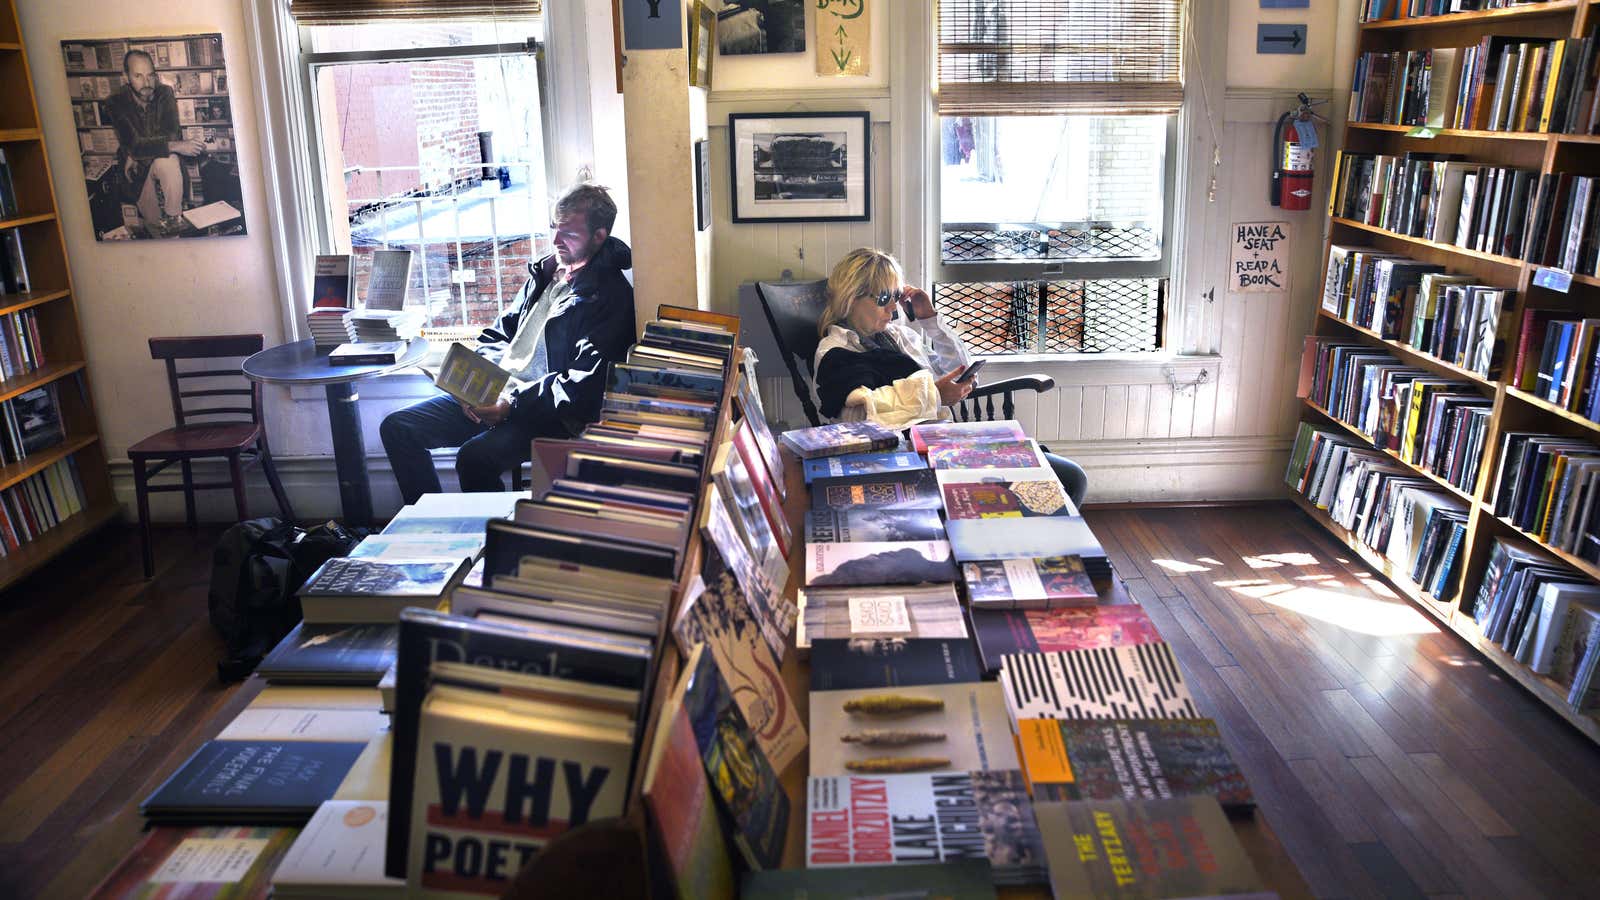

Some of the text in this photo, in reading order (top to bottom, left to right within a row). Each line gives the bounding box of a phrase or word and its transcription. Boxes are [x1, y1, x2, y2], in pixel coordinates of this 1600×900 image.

[645, 0, 661, 19] Y
[1237, 225, 1286, 243] HAVE A
[1243, 238, 1279, 250] SEAT
[1236, 258, 1282, 274] READ A
[1239, 274, 1280, 287] BOOK
[257, 745, 283, 765] THE
[1102, 727, 1118, 749] HAS
[1116, 723, 1151, 787] APPOINTMENT
[1136, 731, 1155, 759] DAWN
[202, 746, 258, 795] VOICEMAILS
[224, 765, 265, 796] FINAL
[1108, 747, 1130, 784] FUTURE
[434, 742, 610, 829] WHY
[811, 807, 850, 864] DANIEL
[850, 777, 894, 864] BORZUTZKY
[931, 775, 988, 863] MICHIGAN
[892, 814, 941, 862] LAKE
[1073, 834, 1098, 863] THE
[1093, 811, 1136, 887] TERTIARY
[423, 832, 543, 882] POET
